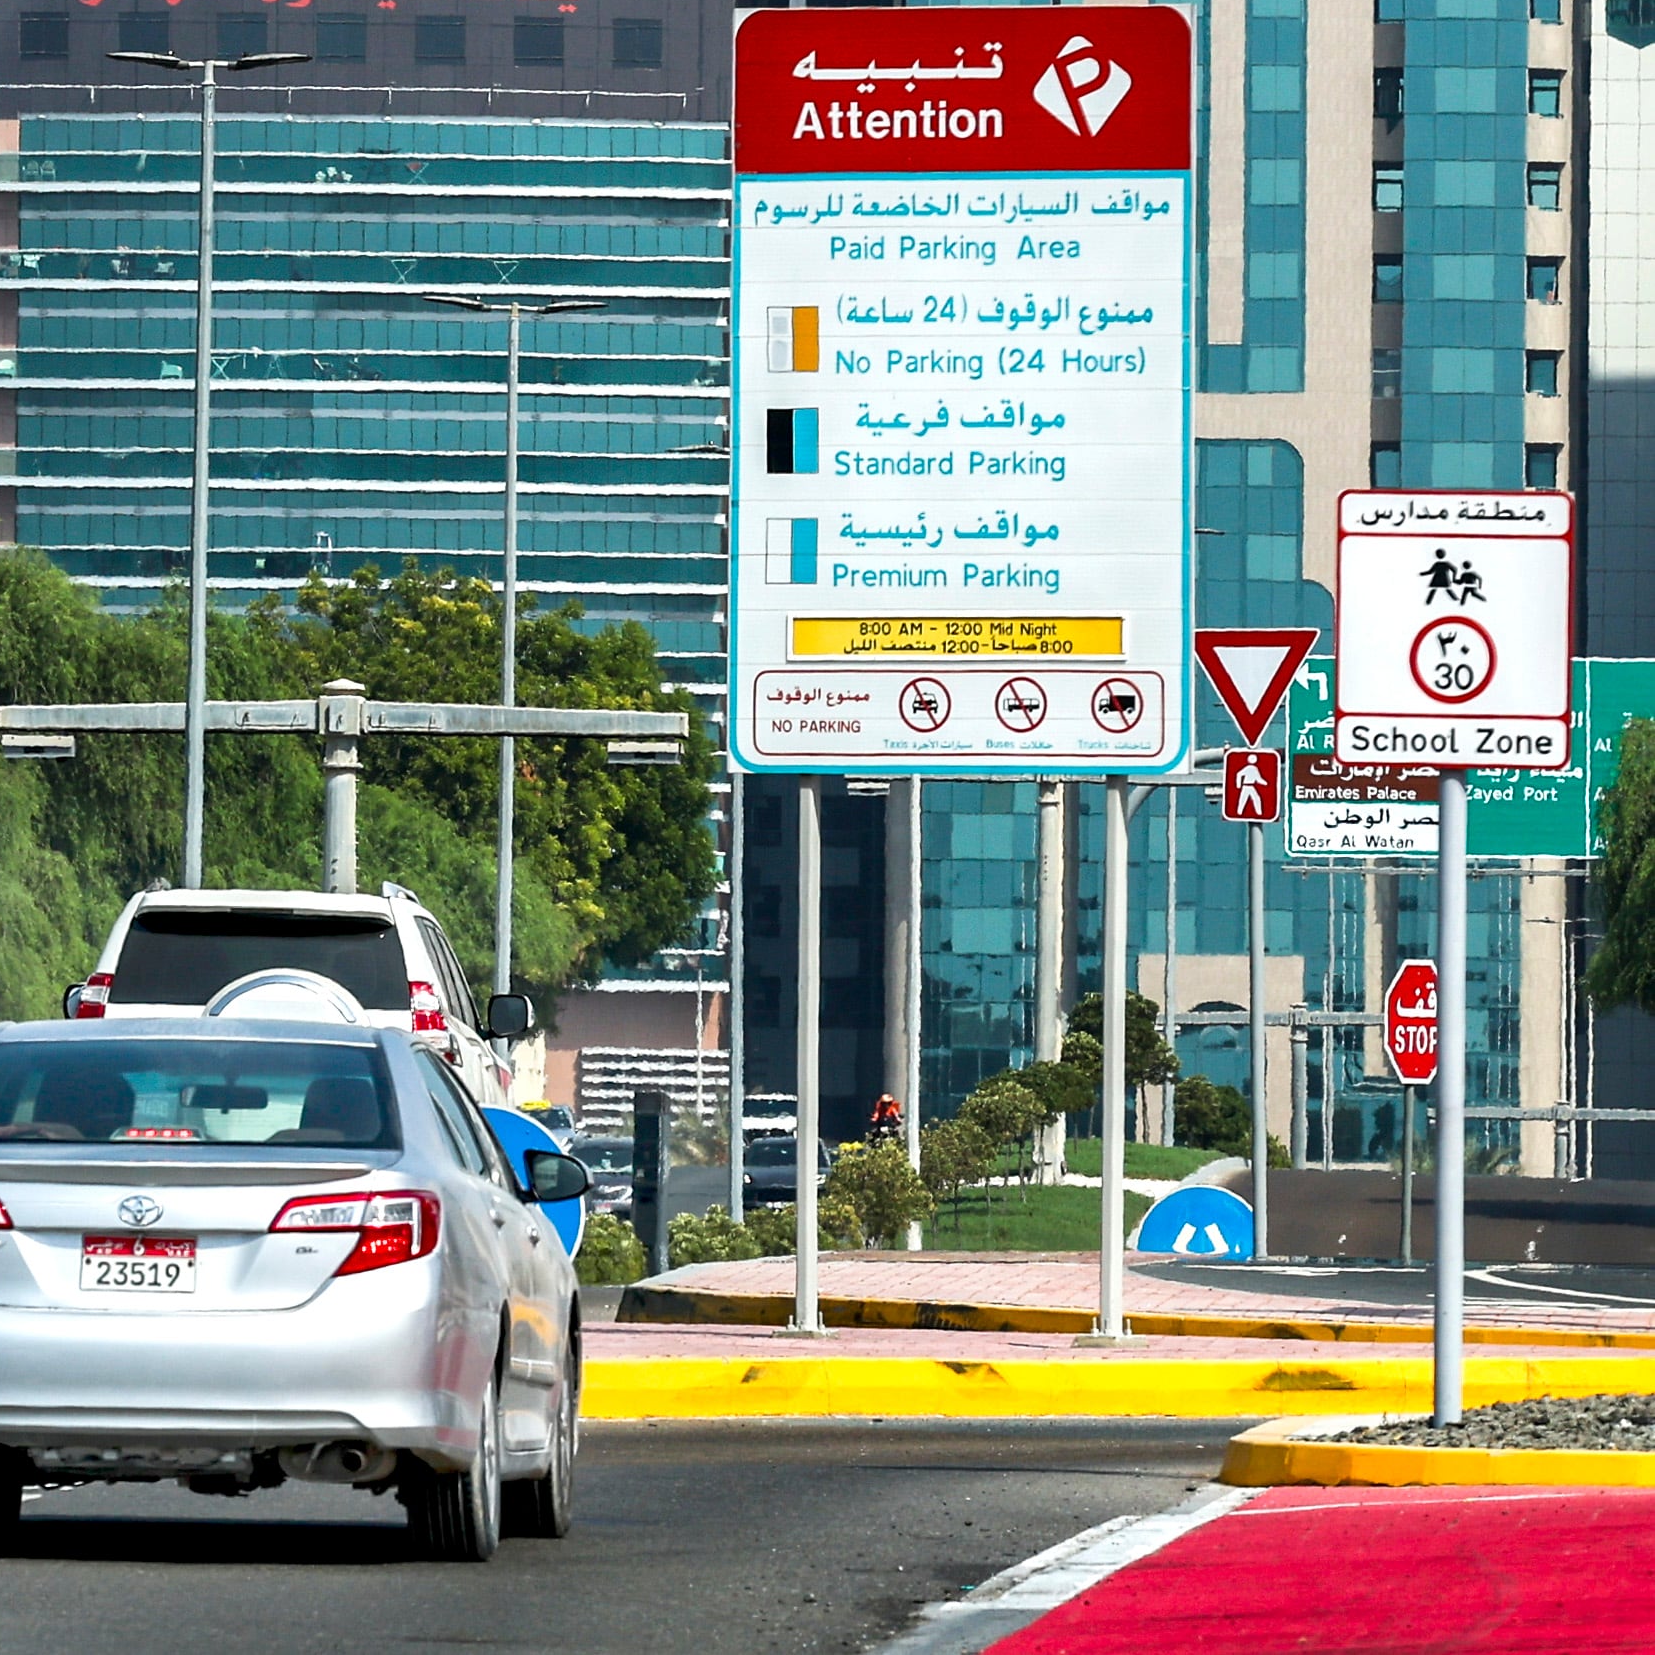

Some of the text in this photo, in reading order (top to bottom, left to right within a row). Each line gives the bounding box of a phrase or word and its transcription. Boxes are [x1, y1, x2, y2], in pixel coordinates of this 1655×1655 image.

[792, 41, 1004, 94] تنبيه
[792, 100, 1004, 140] Attention
[754, 191, 1170, 226] مواقف السيارات الخاضعة للرسوم
[830, 235, 1081, 266] Paid Parking Area
[977, 294, 1070, 325] الوقوف
[1078, 305, 1154, 336] ممنوع
[836, 348, 1146, 379] No Parking (24 Hours)
[856, 399, 1066, 437] مواقف فرعية
[834, 450, 1066, 482] Standard Parking
[1360, 501, 1547, 526] منطقة مدارس
[838, 510, 1060, 547] مواقف رئيسية
[833, 562, 1060, 594] Premium Parking
[859, 622, 892, 636] 8:00
[898, 622, 923, 635] AM
[945, 622, 983, 636] 12:00
[989, 622, 1013, 635] Mid
[1019, 622, 1057, 640] Night
[843, 640, 877, 655] الليل
[880, 641, 937, 652] منتصف
[941, 640, 980, 654] 12:00
[1039, 640, 1073, 654] 8:00
[1437, 631, 1471, 658] ٣٠
[1434, 663, 1474, 690] 30
[766, 686, 871, 707] ممنوع الوقوف
[771, 720, 861, 733] NO PARKING
[1296, 734, 1315, 750] Al
[1351, 725, 1460, 754] School
[1476, 727, 1553, 755] Zone
[1593, 738, 1613, 752] Al
[1294, 785, 1417, 800] Emirates Palace
[1465, 785, 1559, 803] Zayed Port
[1323, 808, 1391, 829] الوطن
[1296, 834, 1414, 848] Qasr Al Watan
[1396, 981, 1438, 1019] قف
[1395, 1024, 1438, 1055] STOP
[133, 1235, 146, 1256] 6
[96, 1261, 180, 1287] 23519
